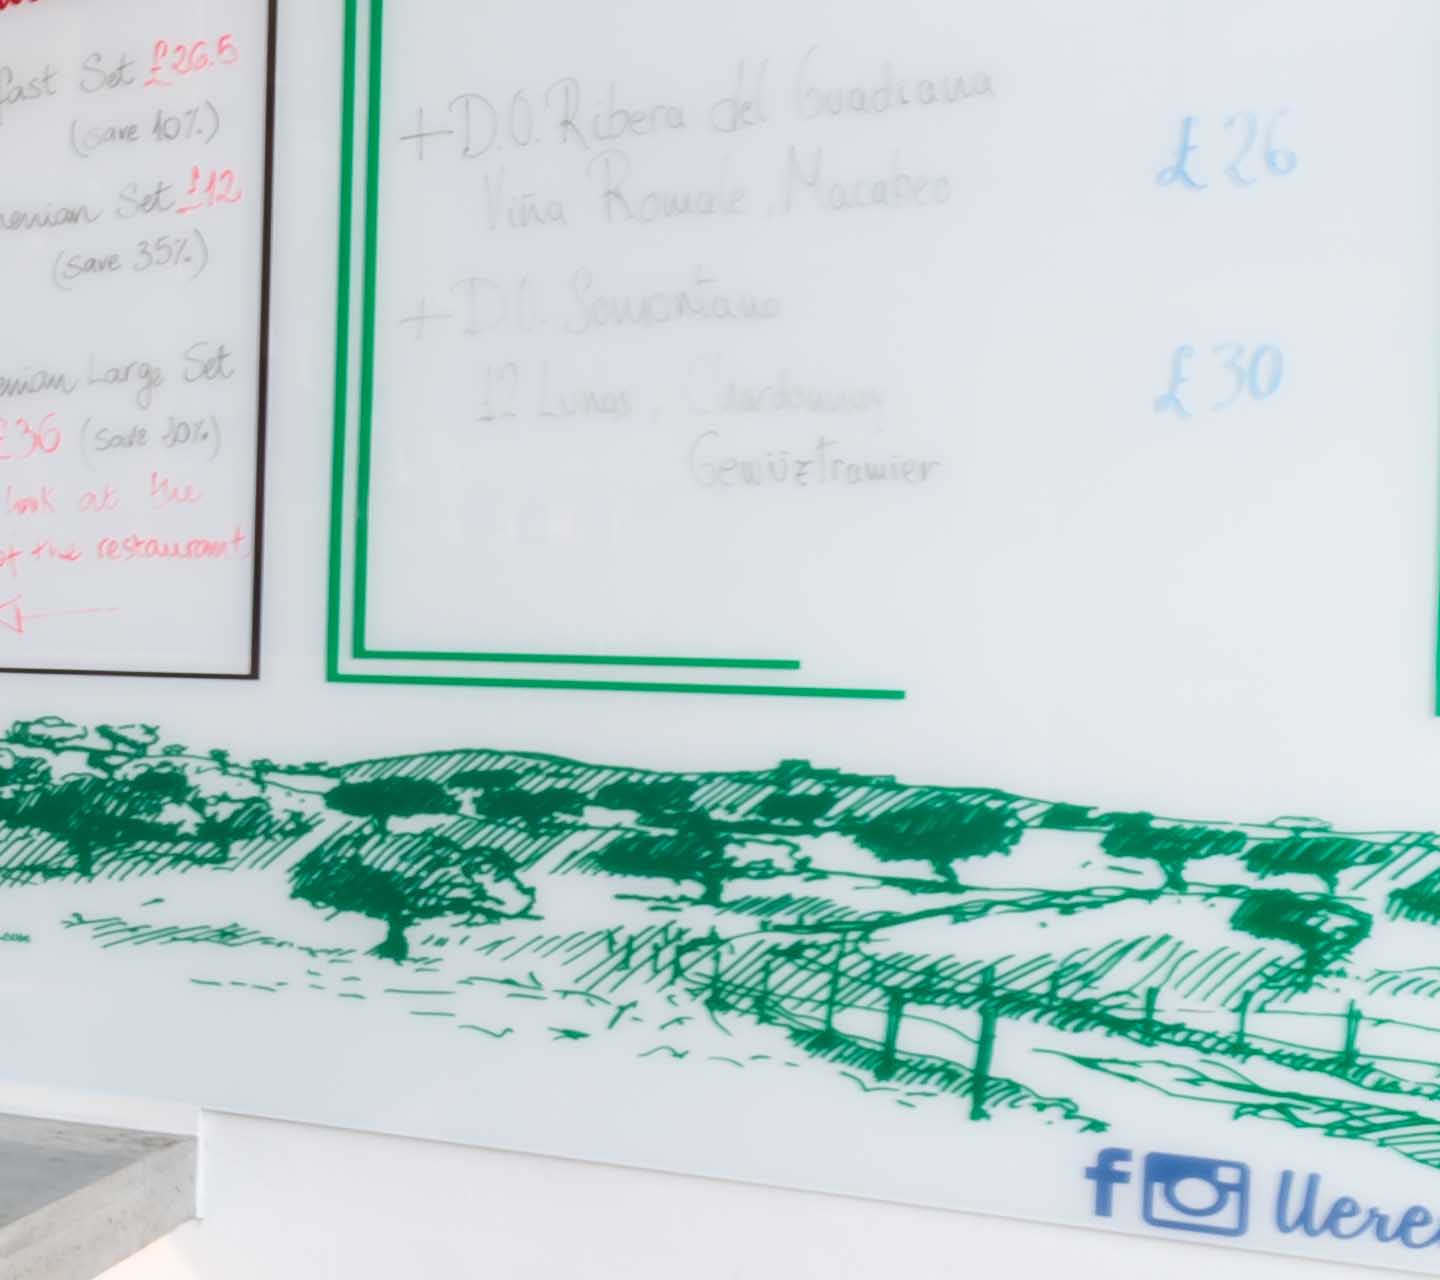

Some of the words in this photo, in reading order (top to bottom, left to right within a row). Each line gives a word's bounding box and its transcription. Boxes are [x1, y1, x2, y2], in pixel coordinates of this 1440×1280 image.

[80, 54, 137, 95] Set
[546, 74, 688, 153] Ribera
[708, 57, 770, 137] del
[116, 181, 177, 219] Set
[183, 341, 236, 382] Set
